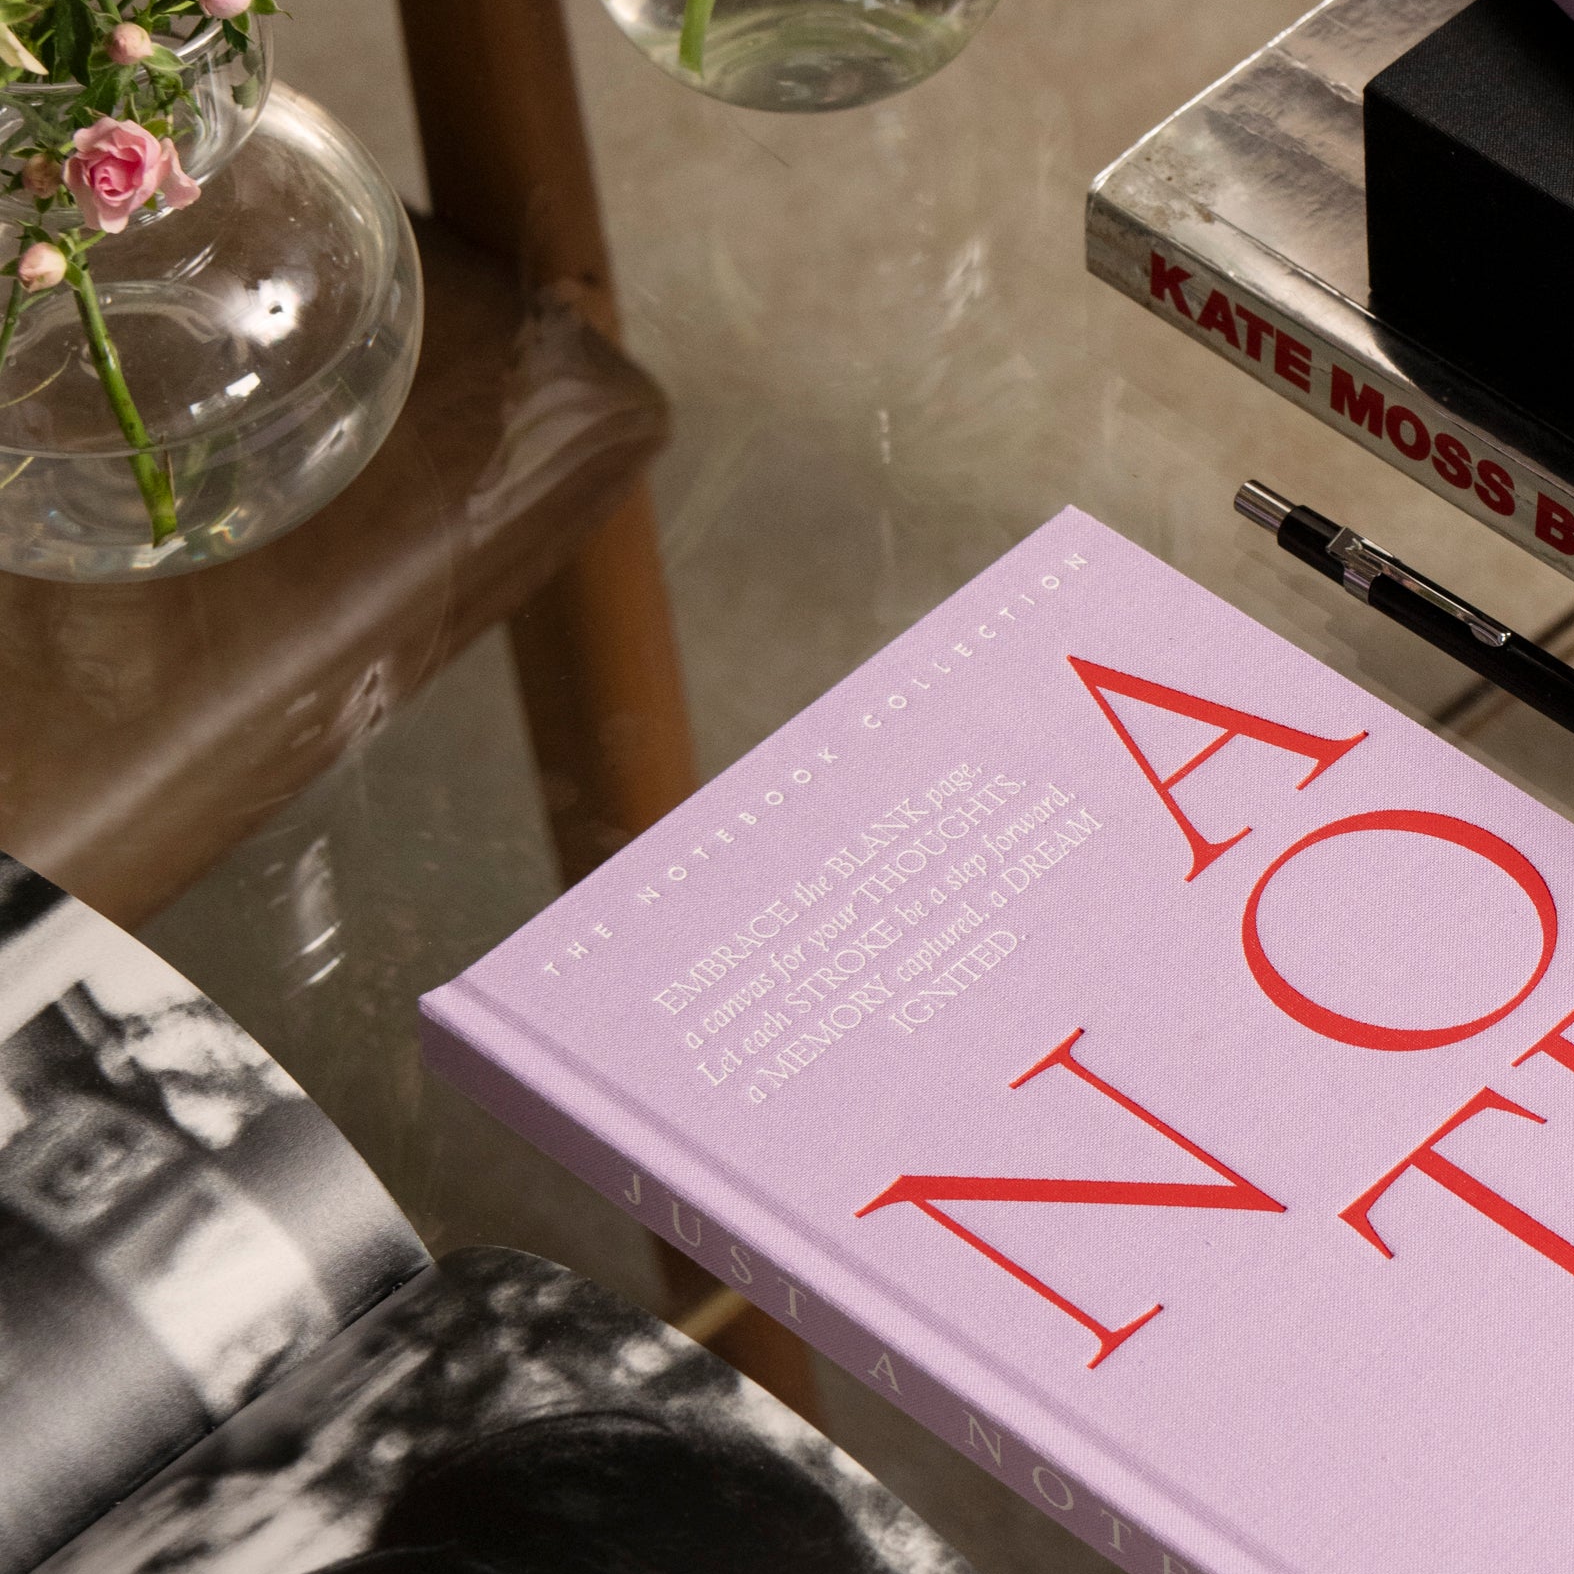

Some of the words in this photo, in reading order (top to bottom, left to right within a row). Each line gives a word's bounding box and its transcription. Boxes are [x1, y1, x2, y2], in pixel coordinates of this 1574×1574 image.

[1149, 251, 1313, 394] KATE
[1330, 363, 1517, 517] MOSS
[543, 922, 613, 979] THE
[637, 747, 839, 906] NOTEBOOK
[862, 551, 1089, 730] COLLECTION
[1001, 807, 1104, 895] DREAM
[1068, 655, 1369, 883] A
[653, 899, 800, 1016] EMBRACE
[794, 875, 834, 907] the
[824, 798, 929, 878] BLANK
[925, 763, 983, 810] page,
[685, 1031, 704, 1050] a
[703, 973, 776, 1034] canvas
[769, 944, 806, 983] for
[808, 903, 858, 953] your
[697, 1047, 743, 1086] Let
[743, 1010, 793, 1055] each
[784, 919, 903, 1014] STROKE
[894, 900, 929, 925] be
[930, 887, 948, 905] a
[946, 854, 987, 891] step
[982, 782, 1076, 864] forward,
[888, 929, 1026, 1034] IGNITED.
[990, 890, 1008, 908] a
[748, 1085, 767, 1104] a
[757, 974, 896, 1089] MEMORY
[623, 1170, 807, 1324] JUST
[867, 1351, 902, 1397] A
